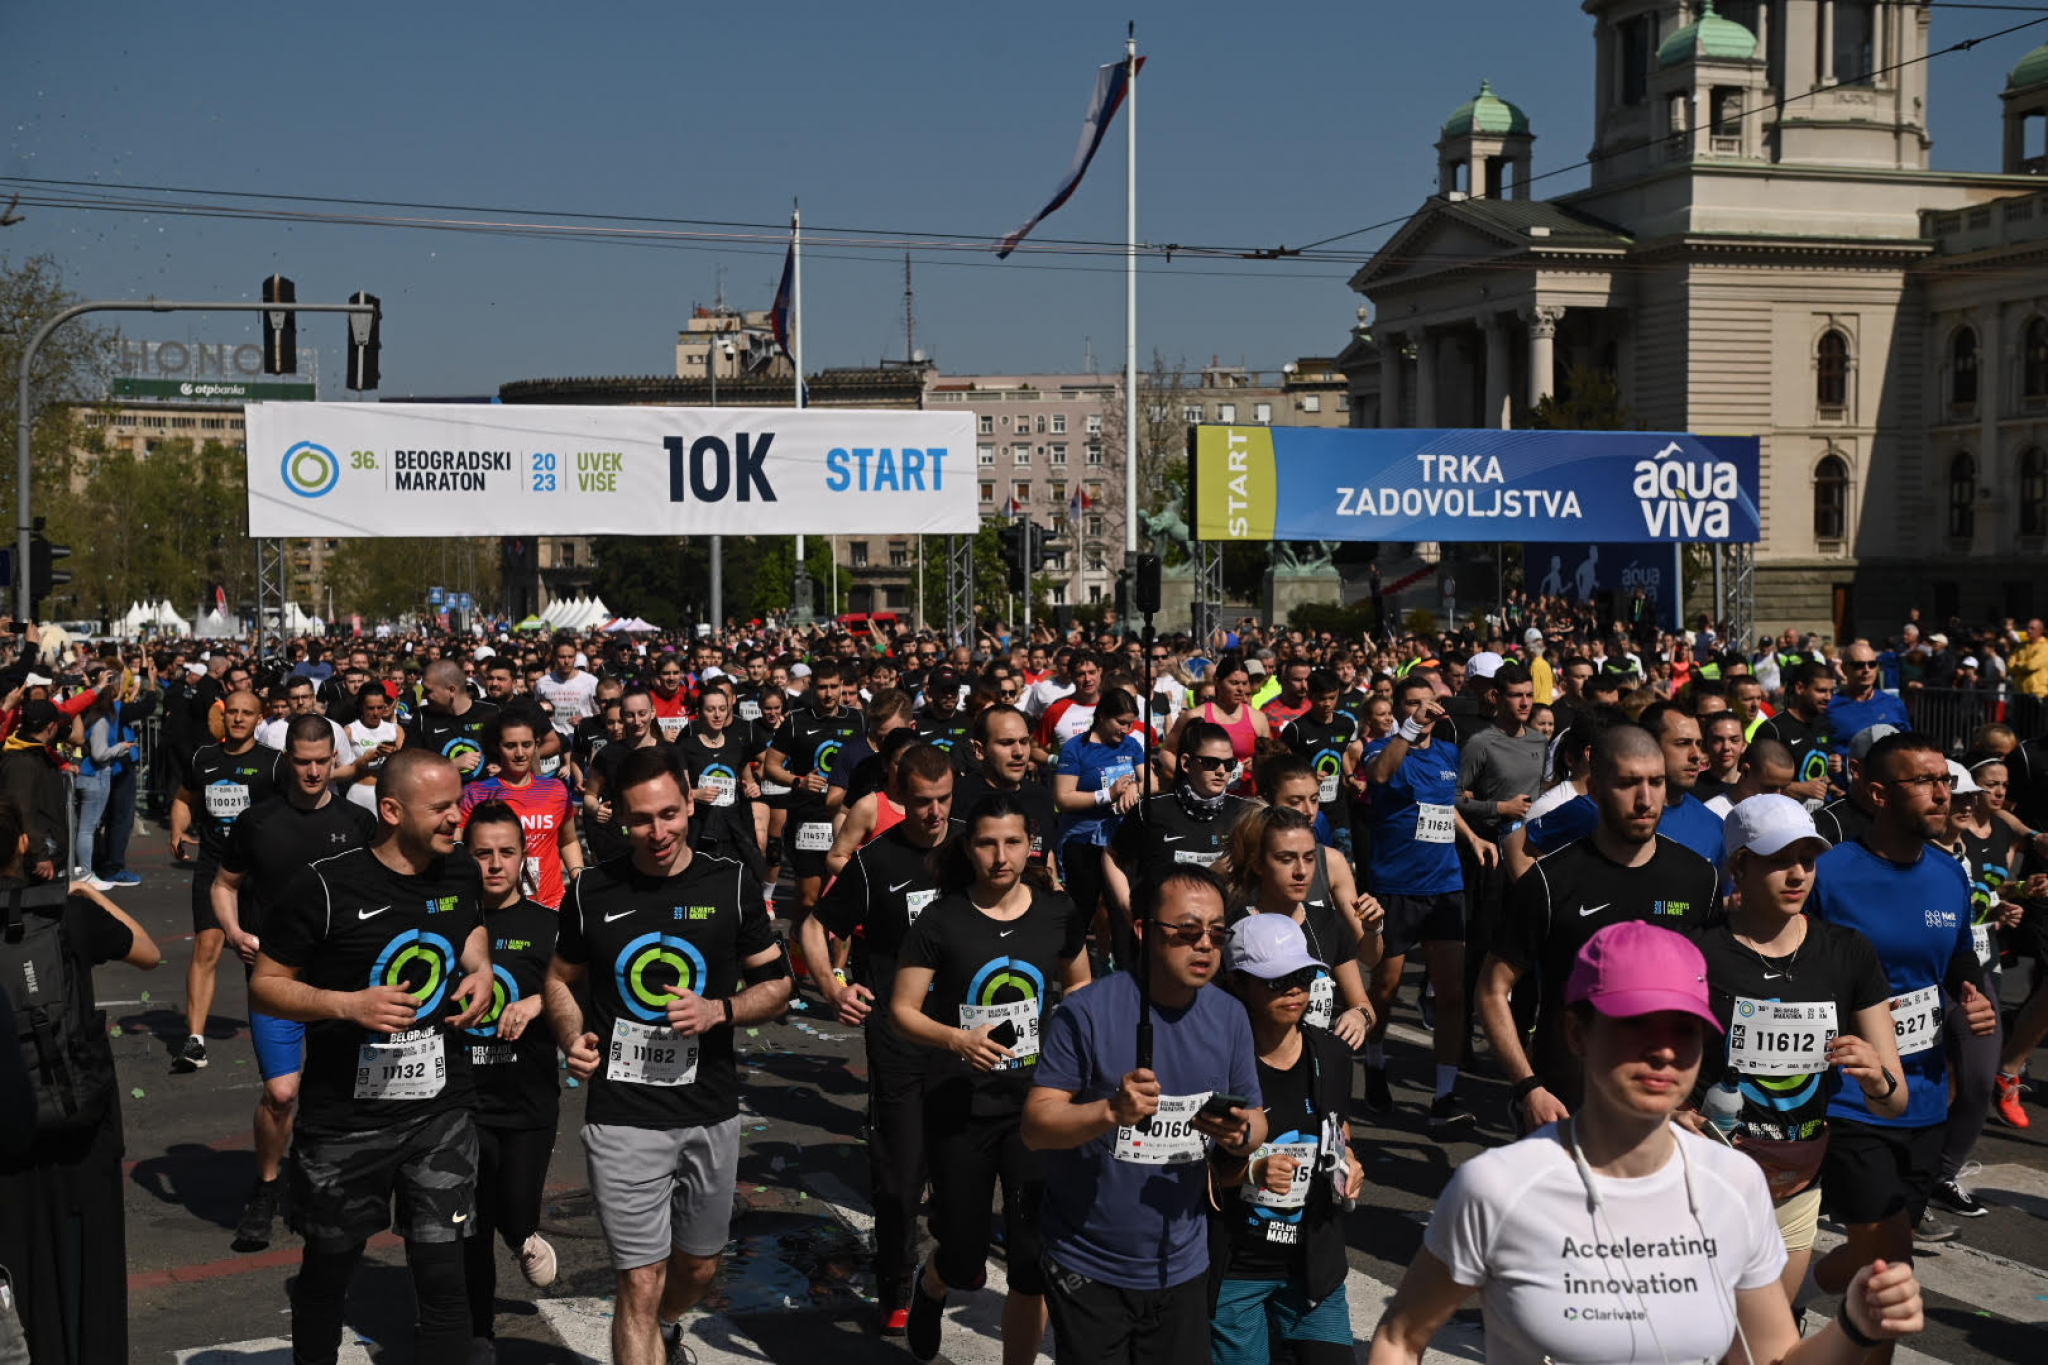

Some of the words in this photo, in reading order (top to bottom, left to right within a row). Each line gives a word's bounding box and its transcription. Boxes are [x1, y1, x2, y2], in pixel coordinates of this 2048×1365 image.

[350, 451, 379, 470] 36.
[395, 450, 511, 471] BEOGRADSKI
[532, 453, 556, 471] 20
[577, 452, 623, 471] UVEK
[664, 432, 778, 503] 10K
[826, 447, 948, 492] START
[1417, 454, 1504, 484] TRKA
[395, 472, 486, 492] MARATON
[533, 474, 556, 492] 23
[1228, 429, 1248, 538] START
[1335, 487, 1583, 519] ZADOVOLJSTVA
[1641, 500, 1731, 538] viva
[213, 798, 241, 807] 10021
[520, 814, 554, 830] NIS
[23, 960, 38, 993] THULE
[1894, 1013, 1926, 1036] 627
[1756, 1030, 1815, 1052] 11612
[633, 1044, 676, 1063] 11182
[382, 1062, 426, 1079] 11132
[1144, 1120, 1194, 1138] 0160
[1269, 1221, 1297, 1232] BELGR
[1562, 1236, 1718, 1259] Accelerating
[1564, 1273, 1698, 1295] innovation
[1582, 1307, 1646, 1321] Clarivate
